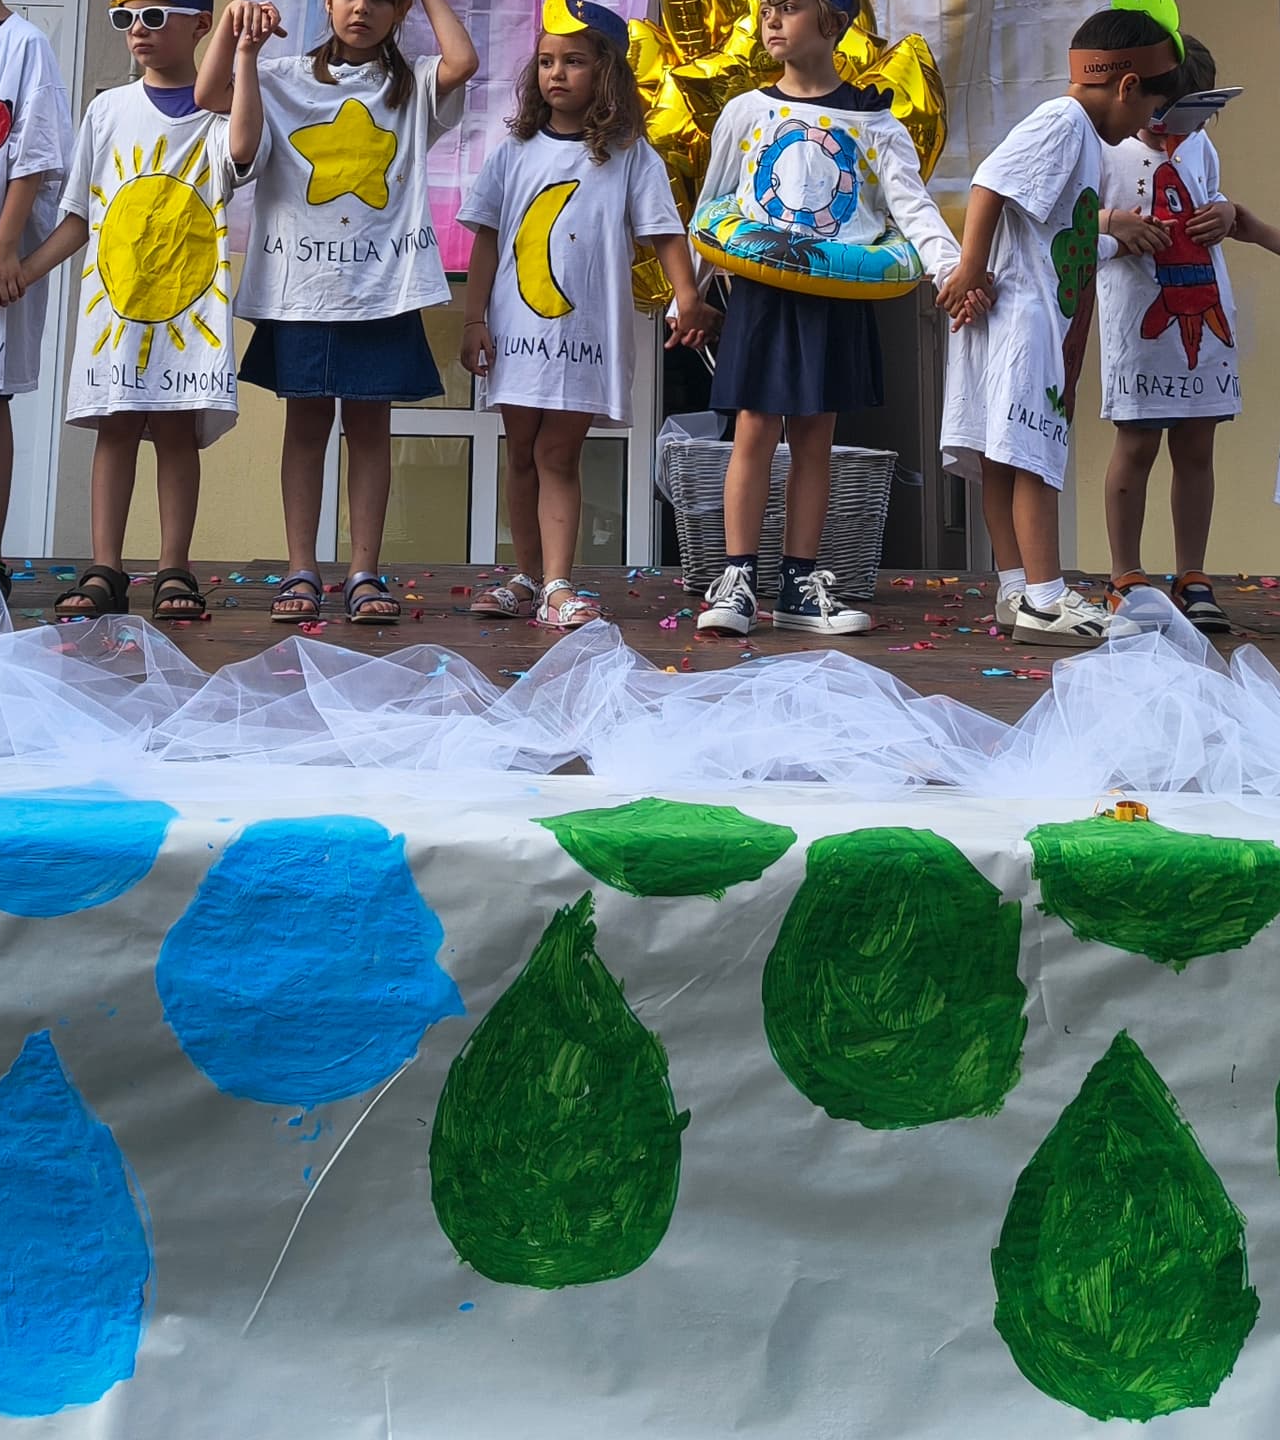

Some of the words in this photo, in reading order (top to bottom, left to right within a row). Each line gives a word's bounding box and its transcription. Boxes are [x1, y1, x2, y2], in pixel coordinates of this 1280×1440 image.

[1083, 60, 1133, 74] LUDOVICO
[264, 234, 284, 254] LA
[297, 236, 383, 262] STELLA
[504, 336, 550, 360] LUNA
[556, 339, 603, 365] ALMA
[87, 368, 101, 387] IL
[111, 364, 148, 390] OLE
[160, 369, 236, 394] SIMONE
[1119, 375, 1129, 395] IL
[1136, 374, 1204, 398] RAZZO
